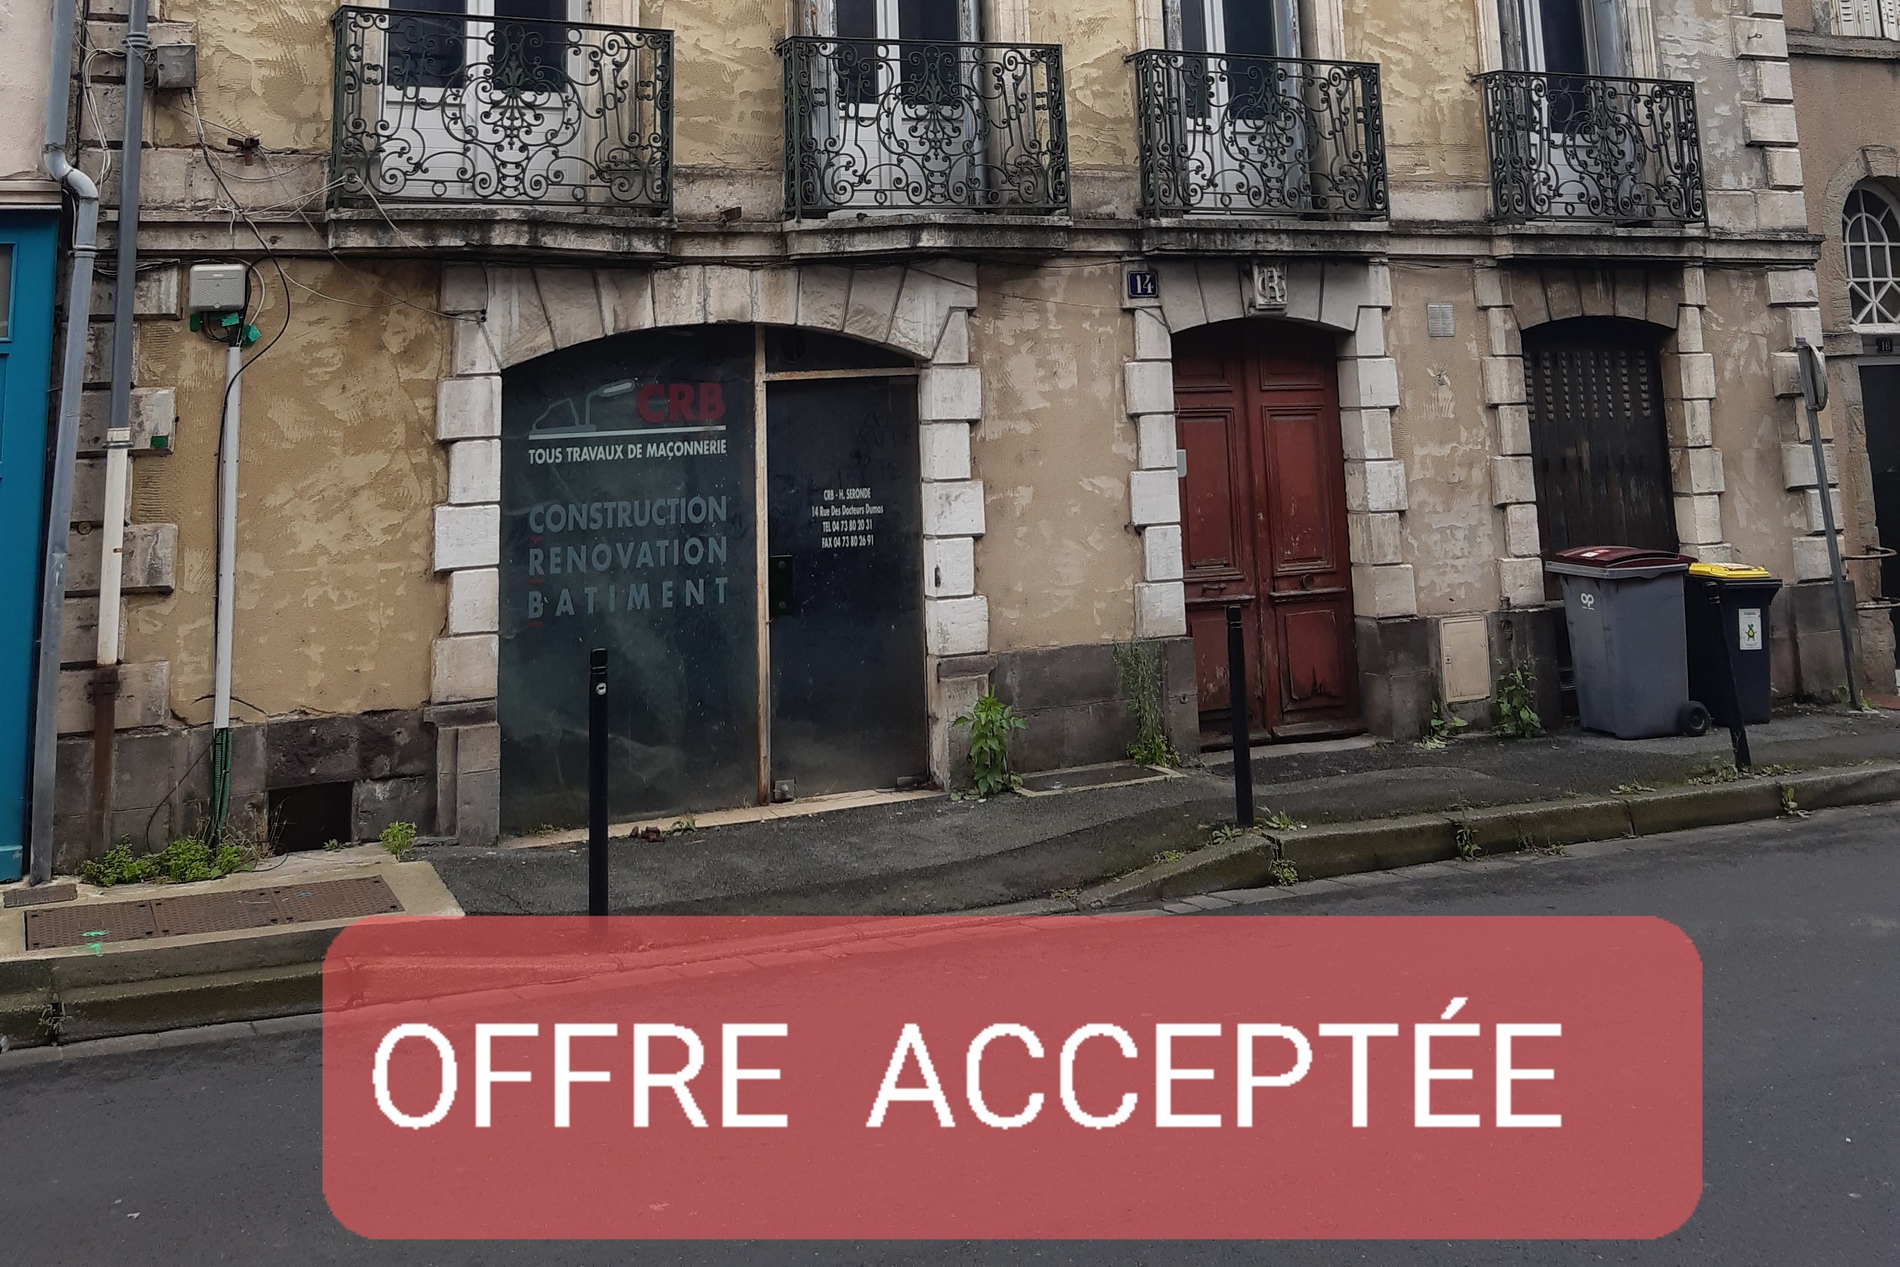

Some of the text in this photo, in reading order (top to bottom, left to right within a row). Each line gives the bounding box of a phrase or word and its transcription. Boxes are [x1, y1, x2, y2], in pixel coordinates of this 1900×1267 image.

[1136, 274, 1154, 294] 14
[1881, 340, 1891, 351] 16
[637, 382, 726, 423] CRB
[528, 439, 727, 464] TOUS TRAVAUX DE MAÇONNERIE
[823, 489, 835, 501] CRB
[529, 495, 727, 534] CONSTRUCTION
[811, 505, 819, 517] 14
[820, 505, 830, 516] Rue
[831, 504, 841, 516] Des
[841, 504, 865, 515] Docteurs
[822, 518, 873, 533] TEL 04 73 80 20 31
[821, 536, 833, 548] FAX
[833, 536, 841, 548] 04
[841, 535, 849, 548] 73
[850, 535, 858, 547] 80
[867, 534, 874, 546] 91
[529, 536, 727, 576] RENOVATION
[528, 577, 728, 619] BATIMENT
